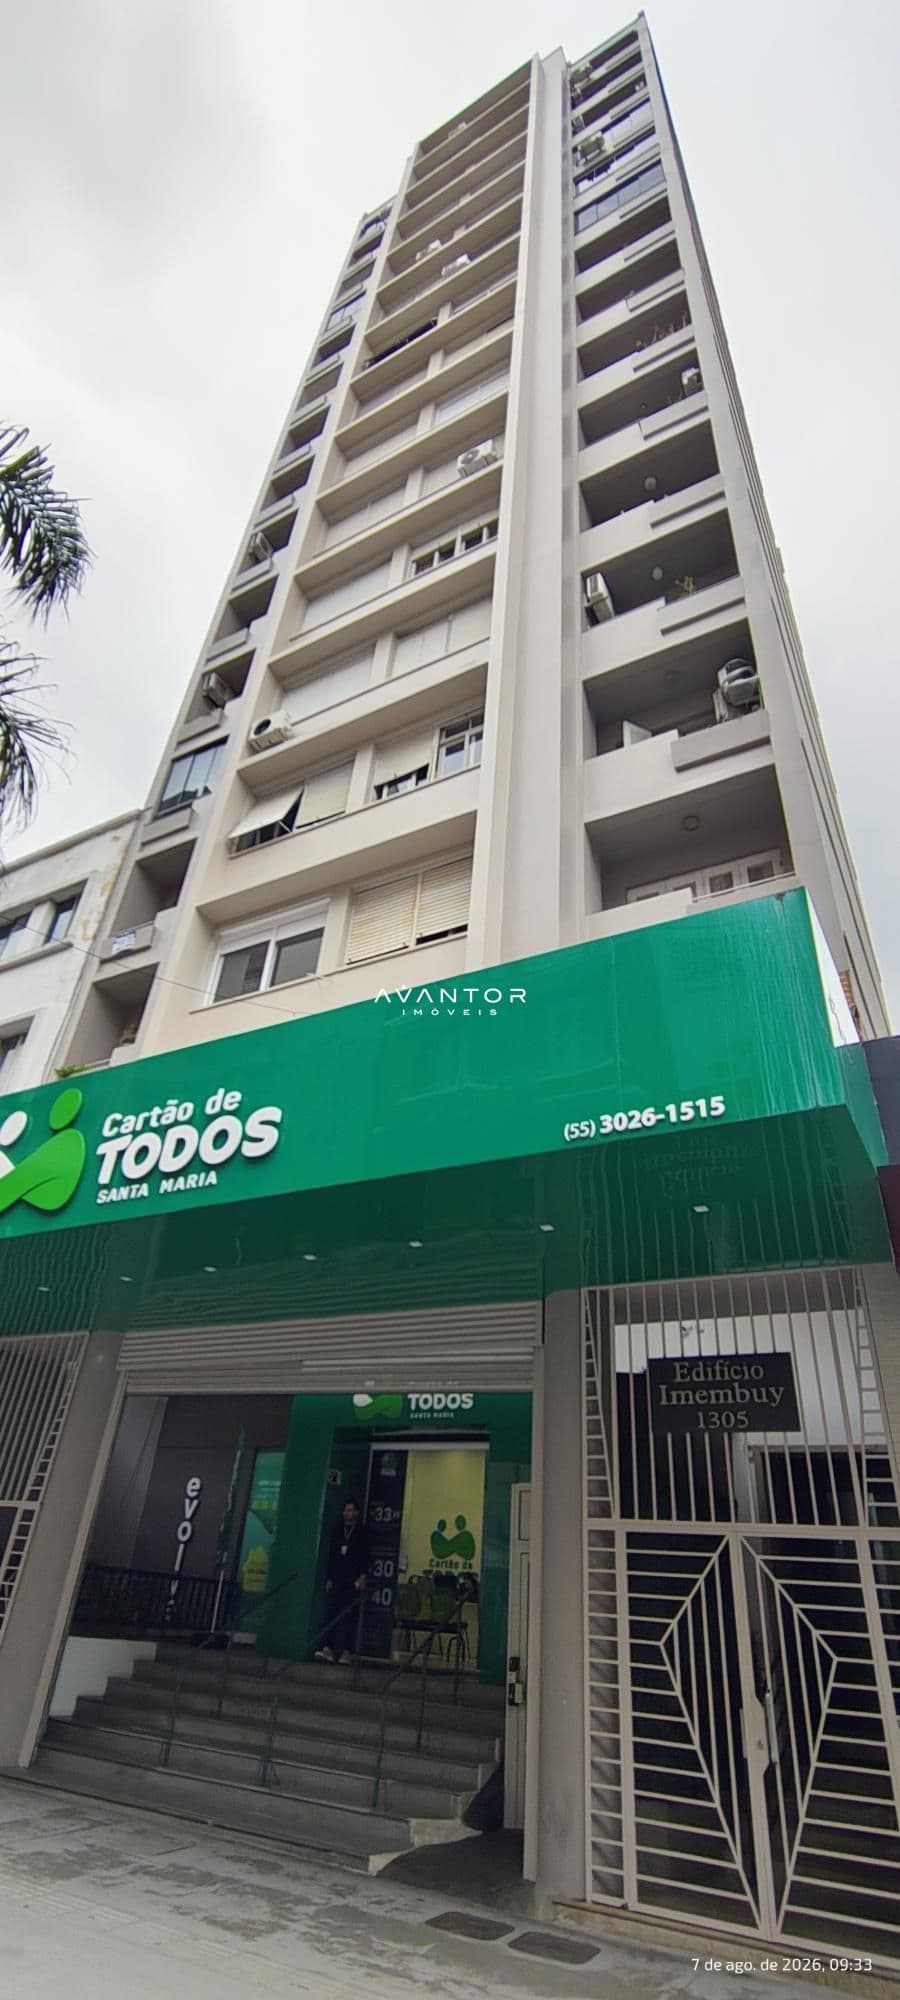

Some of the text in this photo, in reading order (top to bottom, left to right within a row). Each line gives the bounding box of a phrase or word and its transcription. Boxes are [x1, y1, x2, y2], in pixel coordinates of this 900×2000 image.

[102, 1088, 242, 1137] Cartão de
[564, 1096, 726, 1141] (55) 3026-1515
[96, 1106, 282, 1185] TODOS
[96, 1170, 217, 1204] SANTA MARIA
[673, 1360, 765, 1383] Edifício
[407, 1393, 474, 1411] TODOS
[658, 1382, 784, 1407] Imembuy
[697, 1410, 749, 1430] 1305
